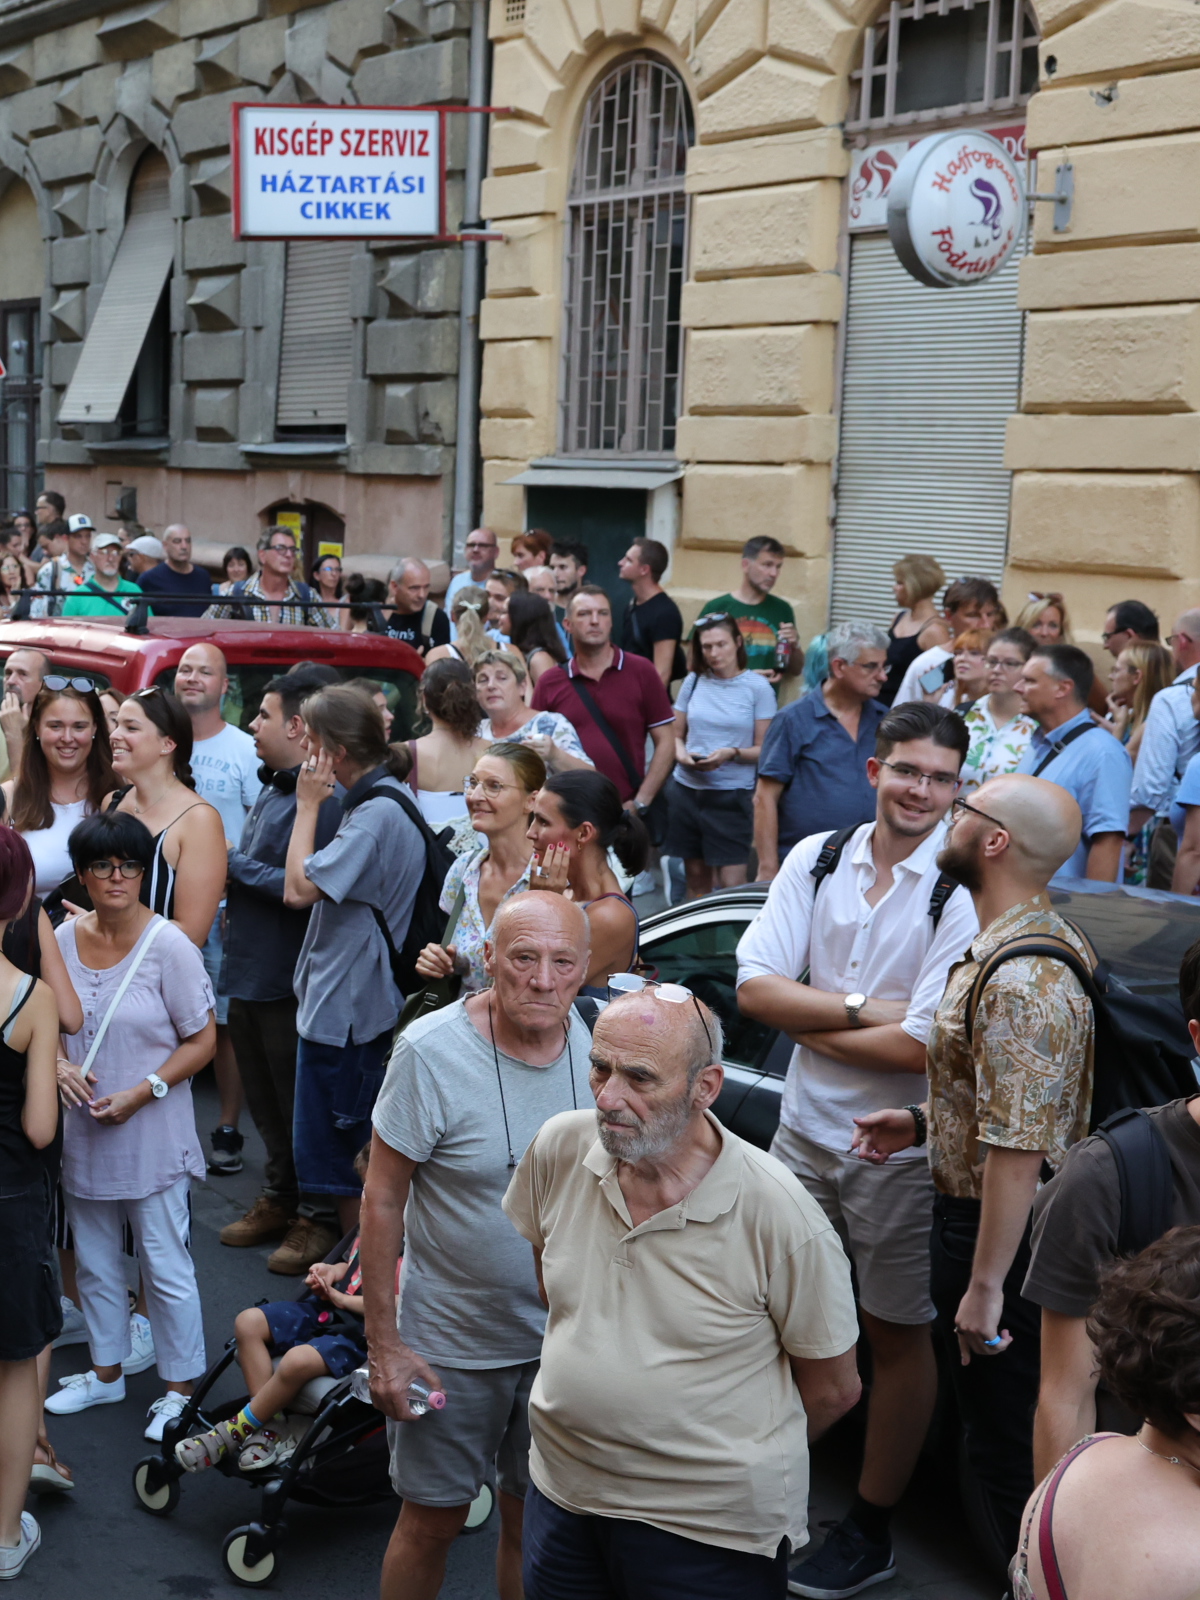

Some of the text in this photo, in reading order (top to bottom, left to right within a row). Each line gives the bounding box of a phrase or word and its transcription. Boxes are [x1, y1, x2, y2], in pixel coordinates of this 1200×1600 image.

[254, 120, 429, 157] KISGÉP SZERVIZ
[260, 170, 425, 194] HÁZTARTÁSI
[300, 201, 392, 220] CIKKEK
[193, 755, 230, 773] AILOR
